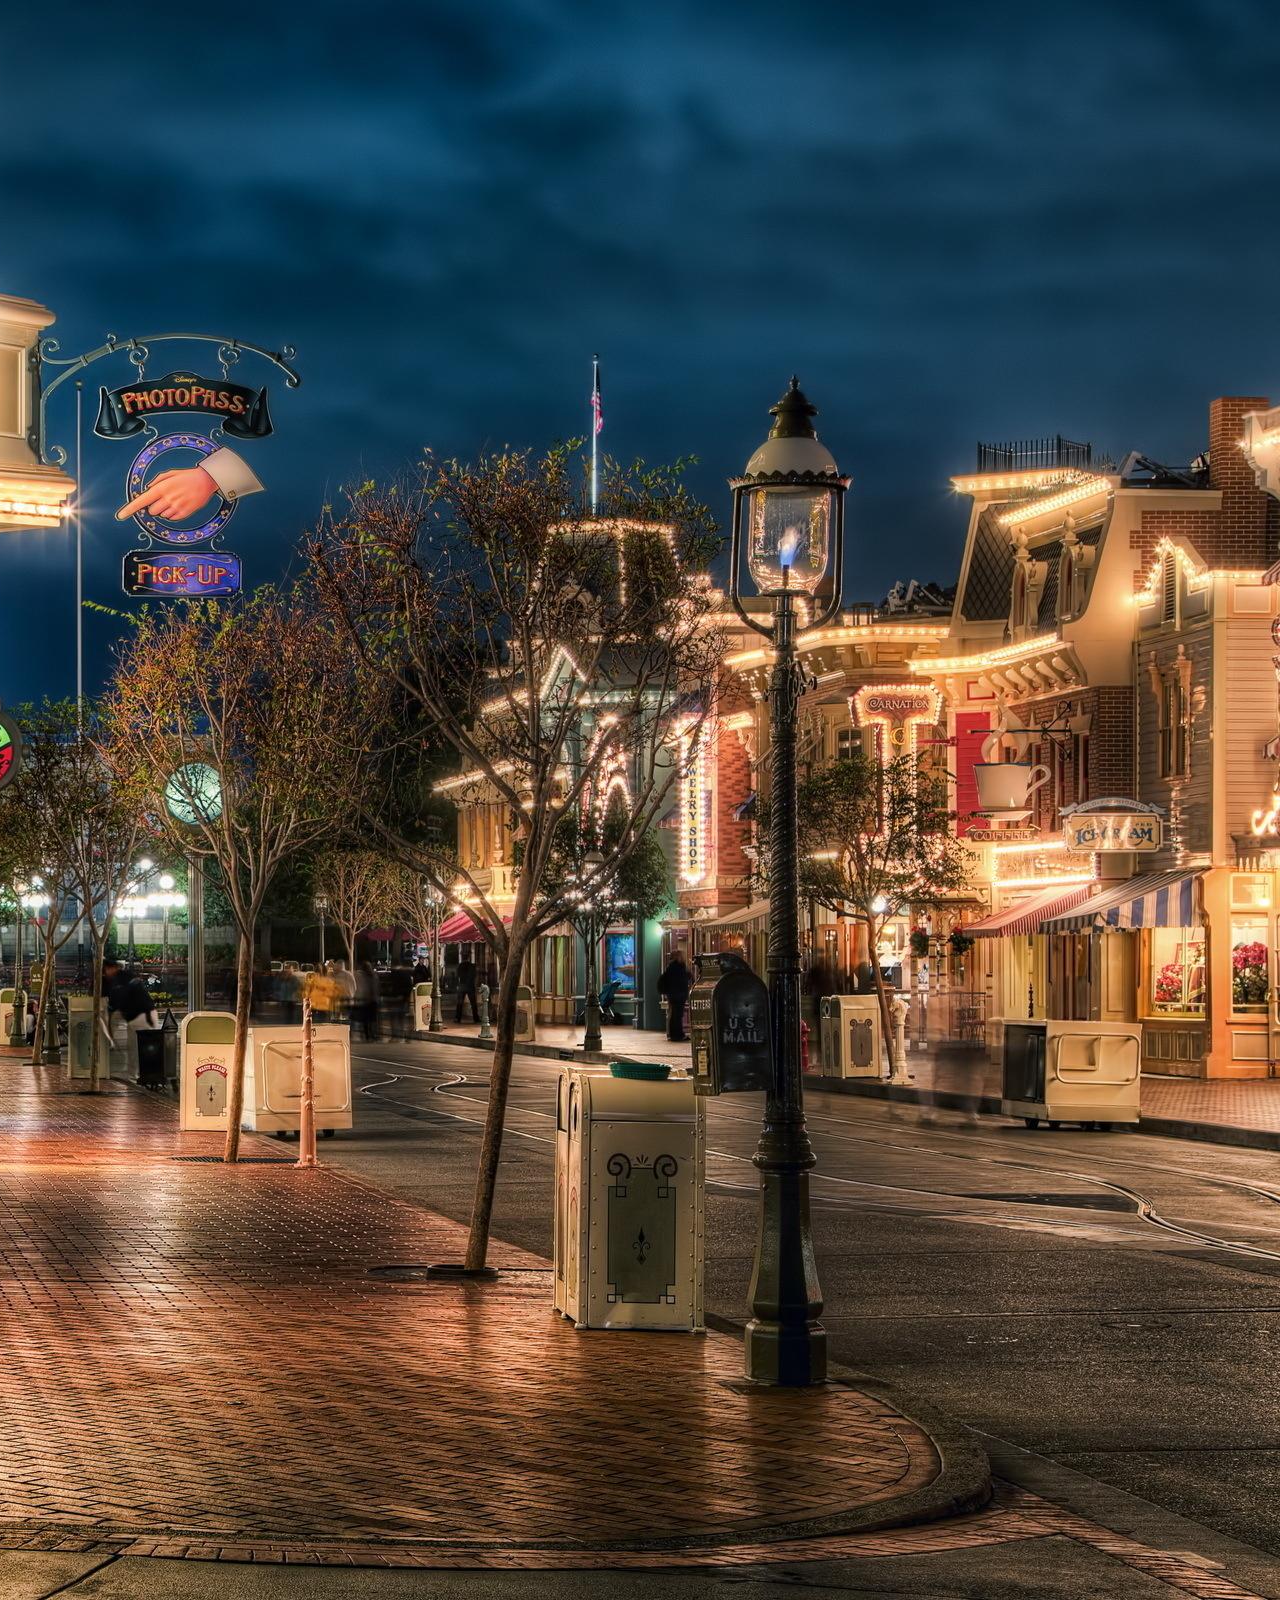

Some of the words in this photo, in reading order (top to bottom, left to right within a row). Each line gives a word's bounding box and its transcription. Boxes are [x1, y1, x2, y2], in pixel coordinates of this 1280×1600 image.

[136, 563, 228, 585] PICK-UP
[865, 697, 929, 713] CARNATION
[689, 827, 698, 869] SHOP
[723, 1031, 763, 1044] MAIL
